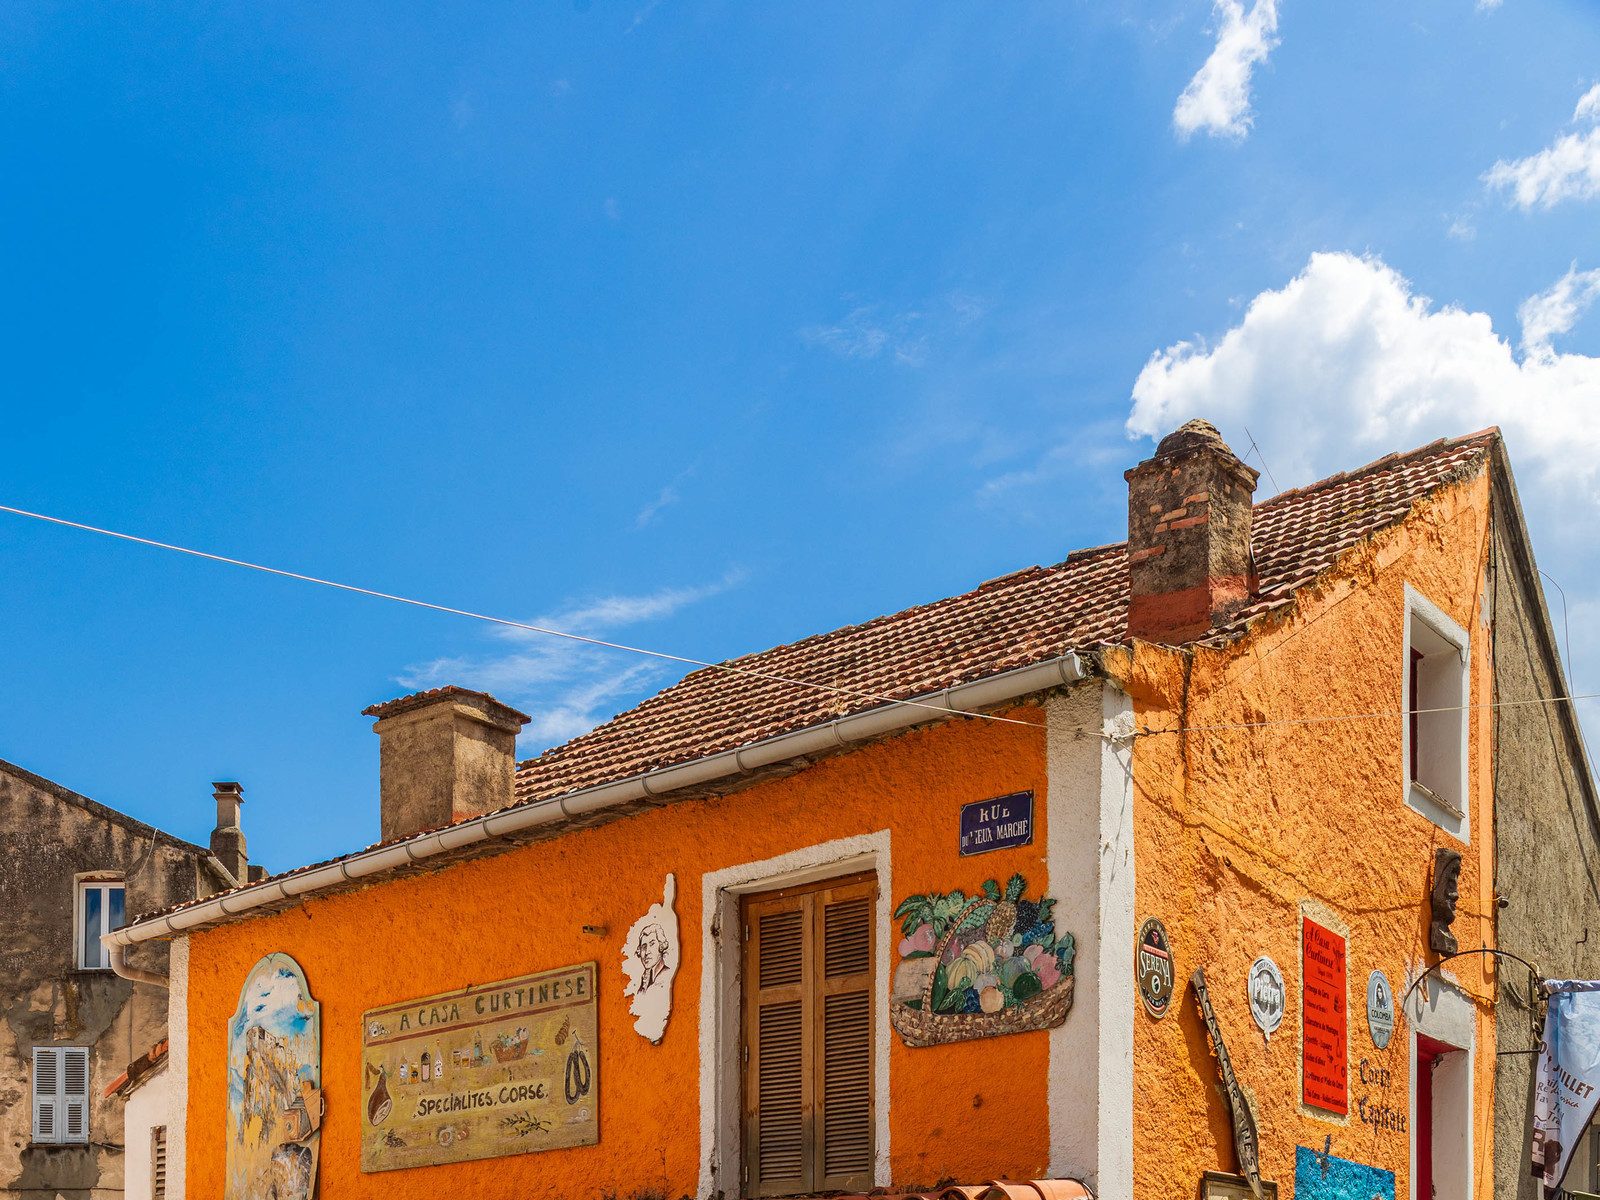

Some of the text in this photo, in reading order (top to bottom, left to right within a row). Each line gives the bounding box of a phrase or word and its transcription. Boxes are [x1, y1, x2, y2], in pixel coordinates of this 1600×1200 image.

[979, 804, 1010, 823] RUE
[1139, 950, 1172, 988] SERENA
[399, 976, 586, 1031] A CASA CURTINESE
[1253, 977, 1280, 1005] Pietra
[1370, 1008, 1392, 1022] COLOMBA
